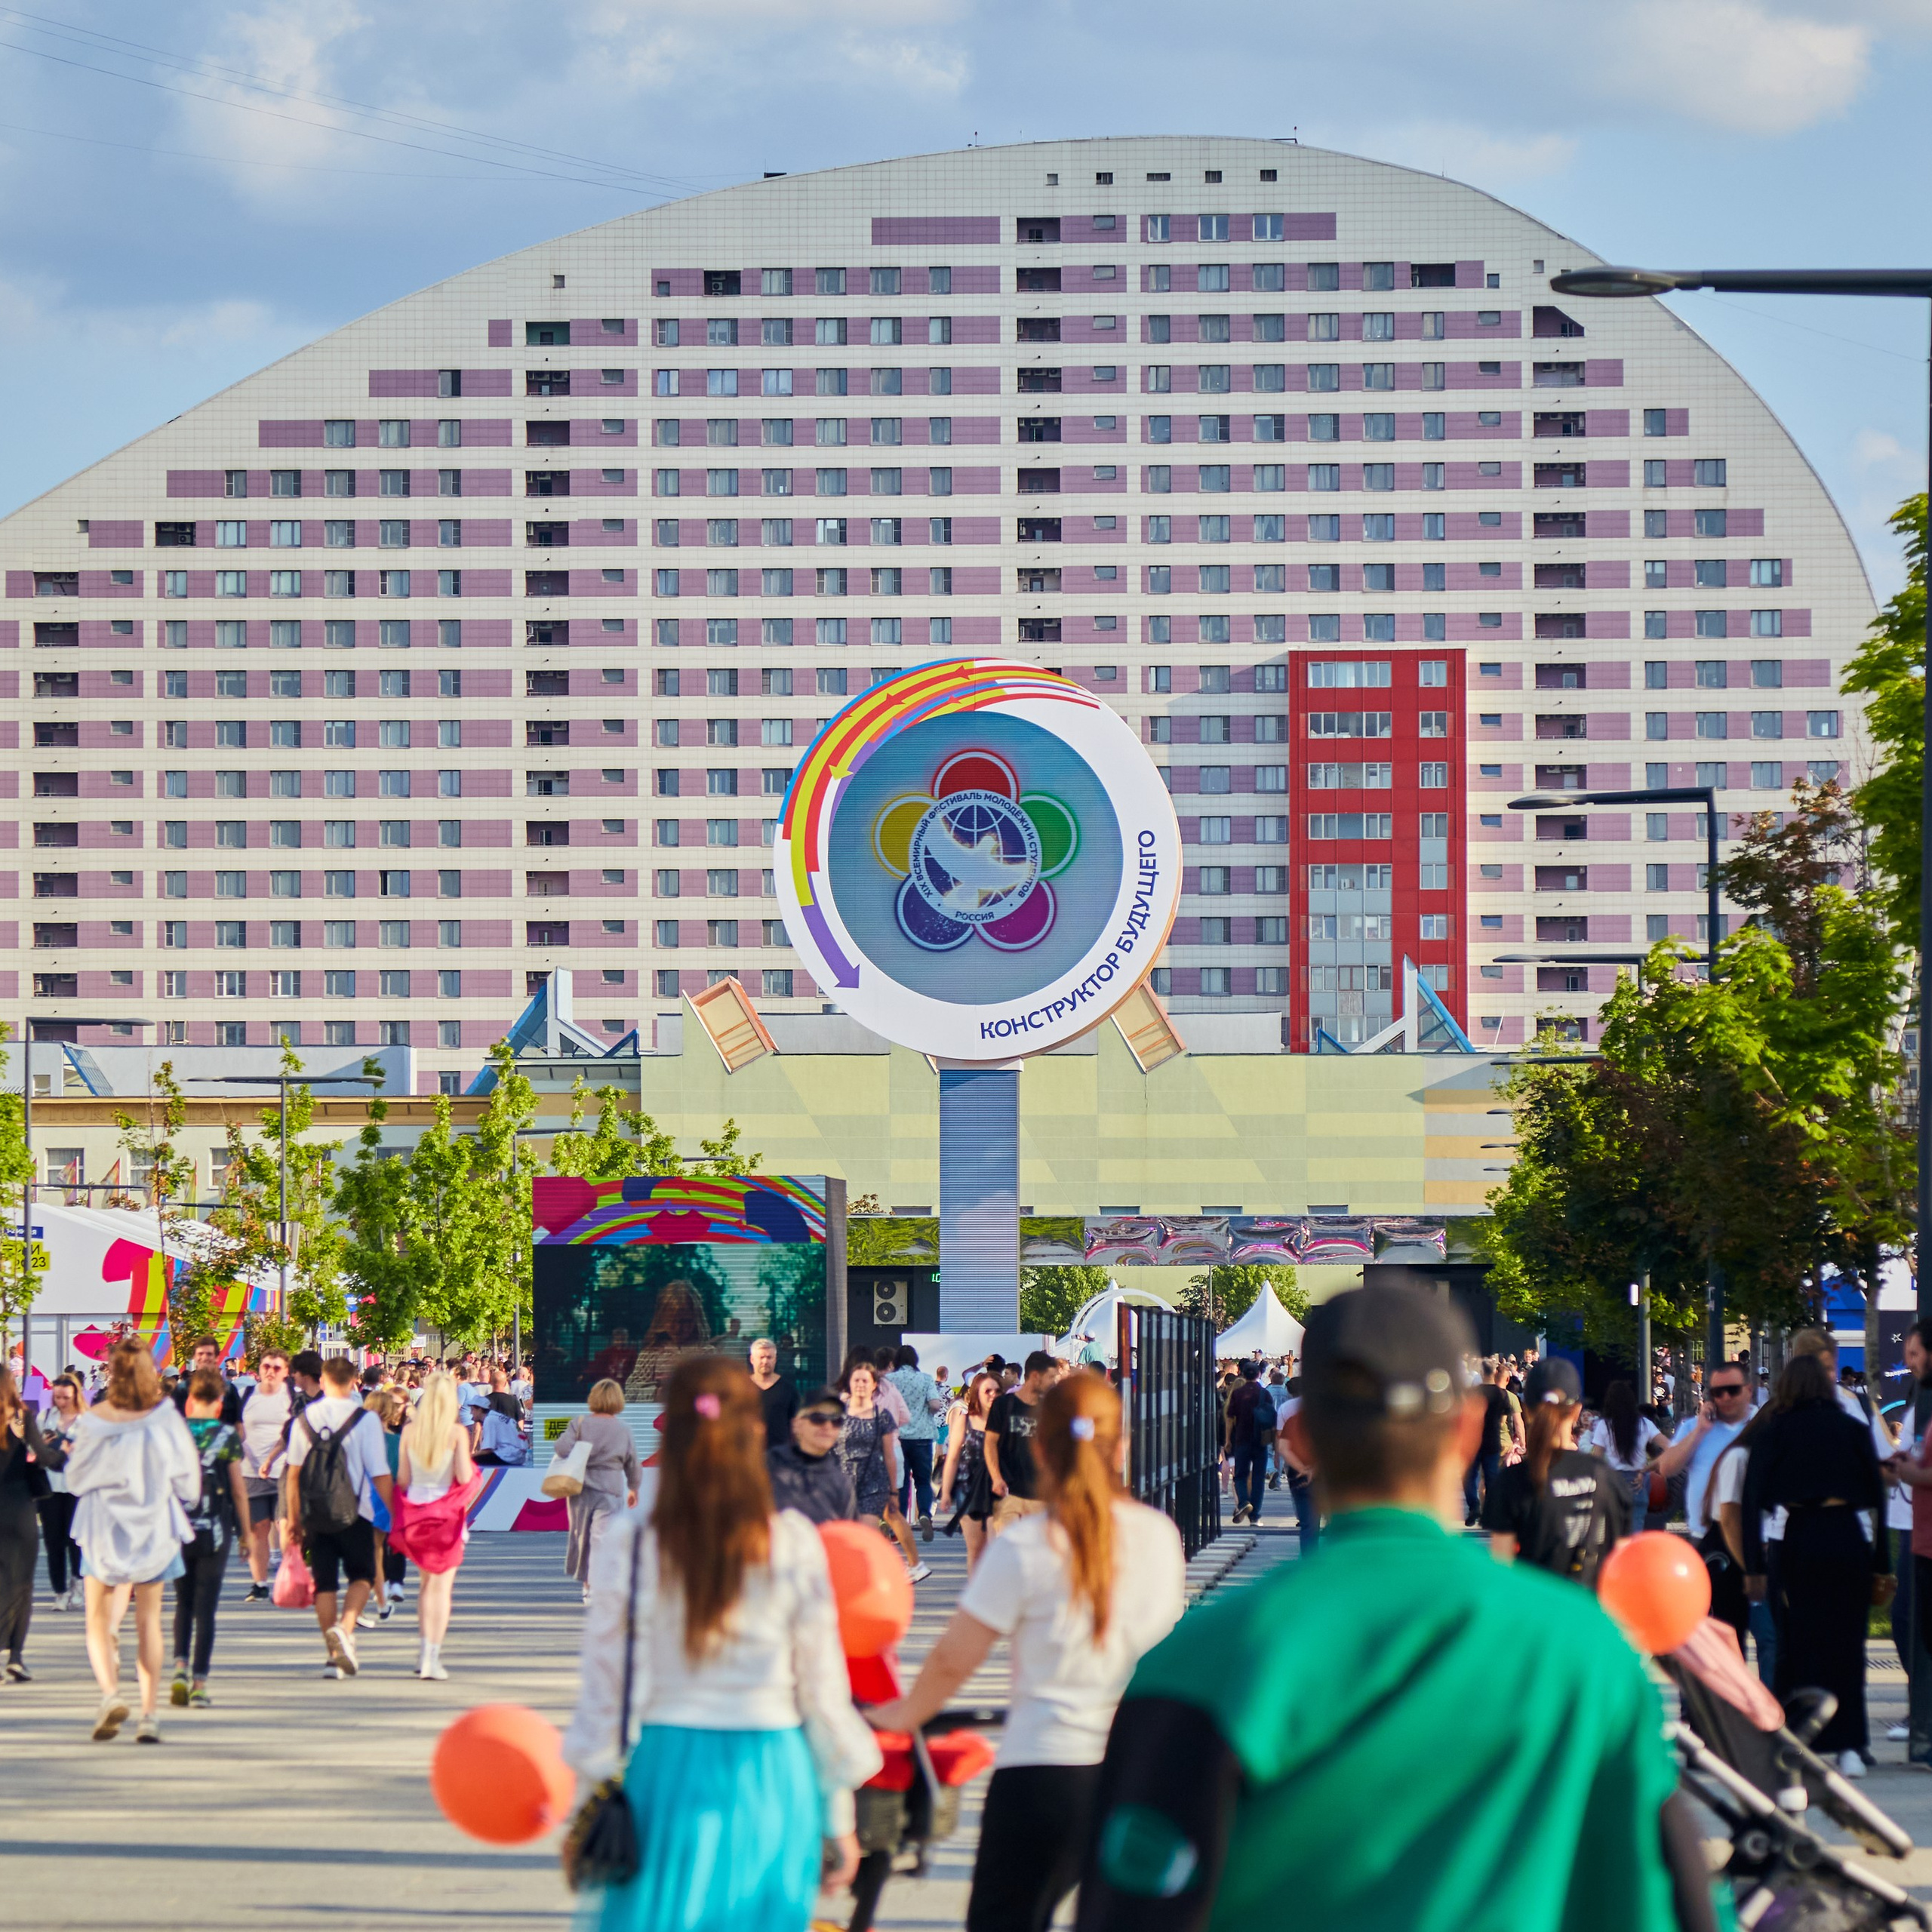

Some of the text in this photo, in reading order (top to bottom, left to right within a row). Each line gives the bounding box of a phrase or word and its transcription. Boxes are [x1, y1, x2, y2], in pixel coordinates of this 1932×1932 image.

[928, 792, 982, 819] ФЕСТИВАЛЬ
[983, 793, 1031, 832] МОЛОДЁЖИ
[1026, 832, 1035, 840] И
[912, 819, 931, 881] ВСЕМИРНЫЙ
[919, 881, 933, 898] XIX
[955, 911, 995, 921] РОССИЯ
[980, 829, 1160, 1040] КОНСТРУКТОР БУДУЩЕГО
